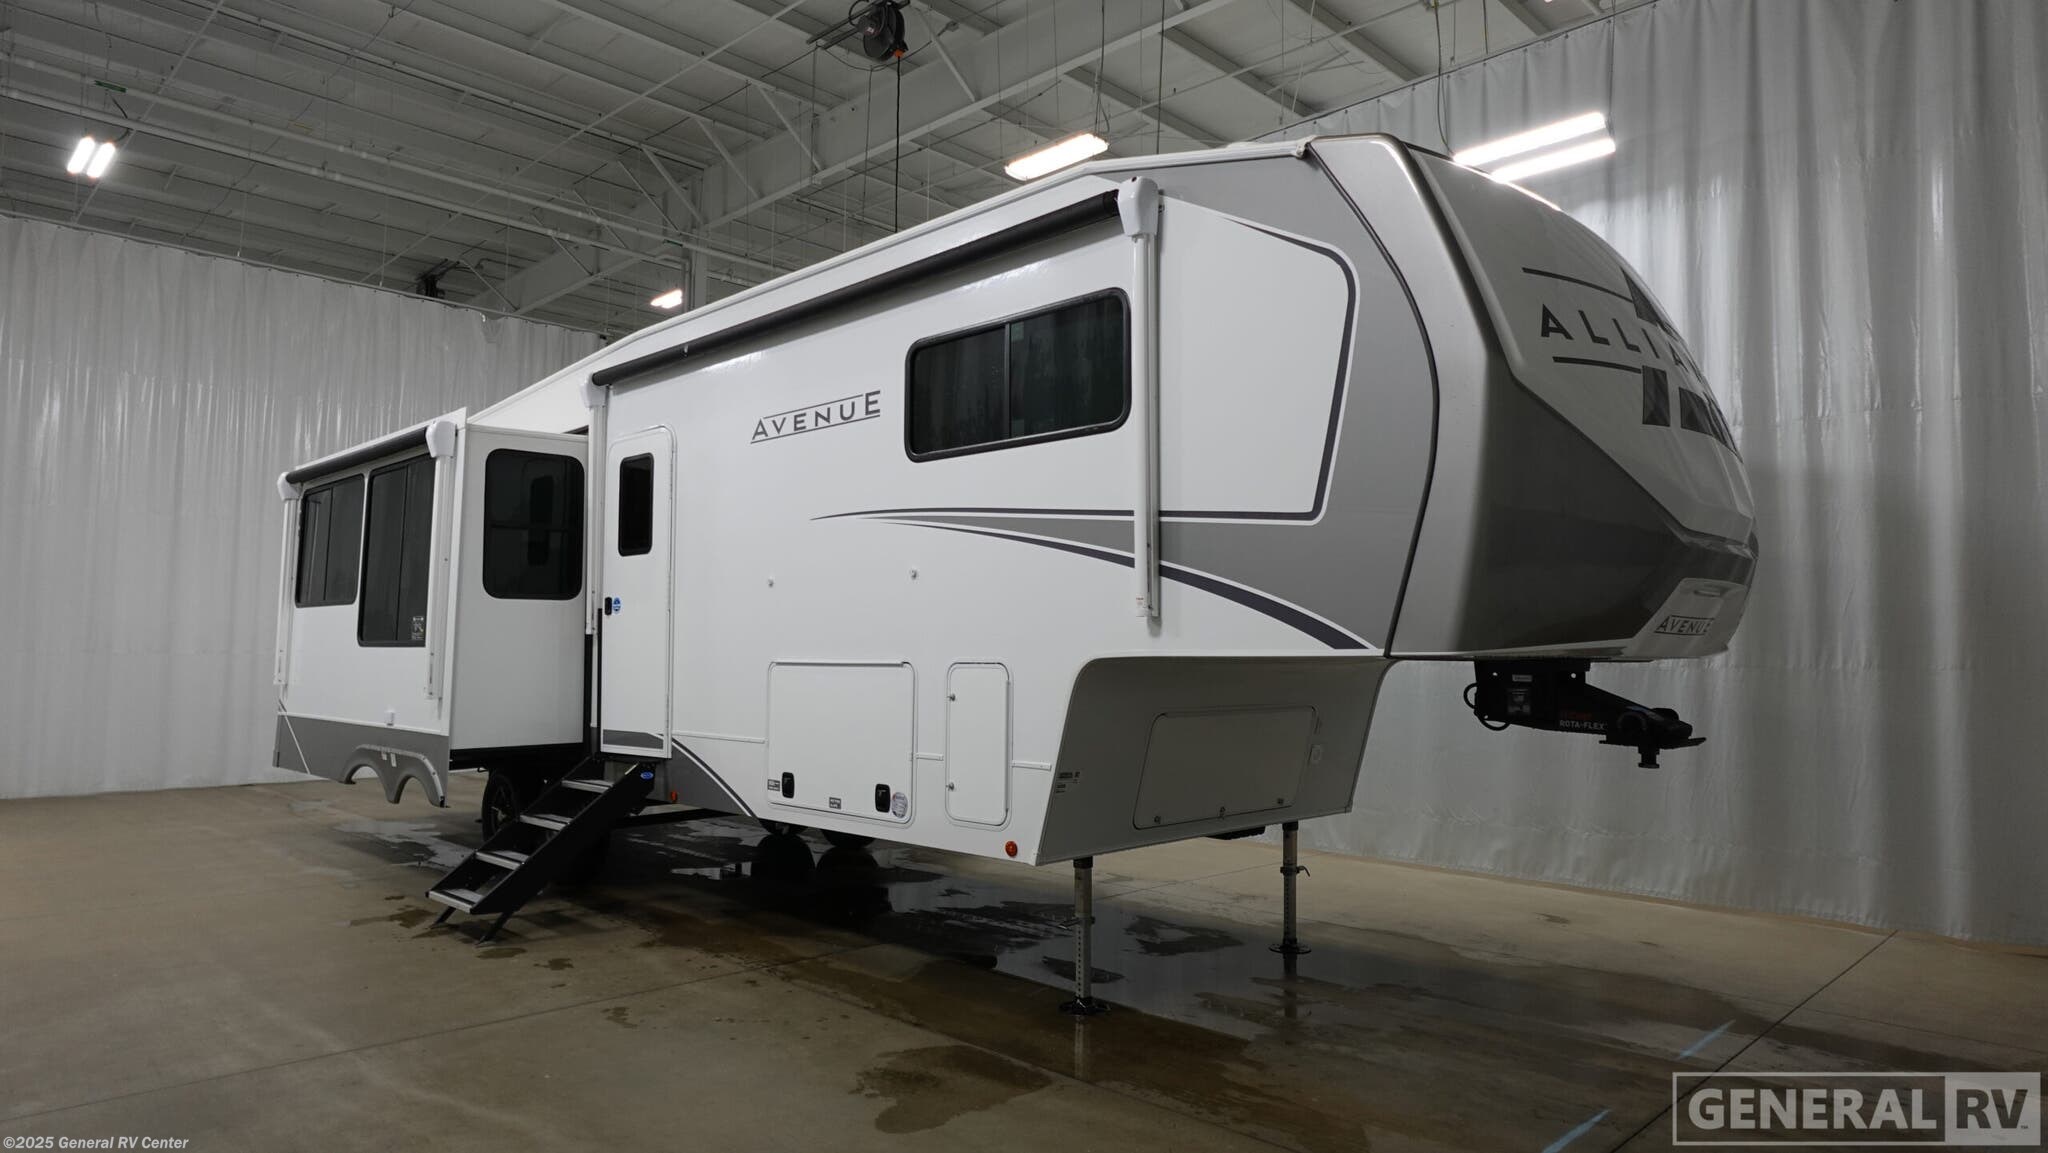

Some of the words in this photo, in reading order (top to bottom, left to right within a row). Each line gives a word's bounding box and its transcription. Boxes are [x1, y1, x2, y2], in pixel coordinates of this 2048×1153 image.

[752, 390, 881, 441] AVENUE
[1656, 615, 1711, 633] AVENUE
[1559, 719, 1604, 730] ROTA-FLEX
